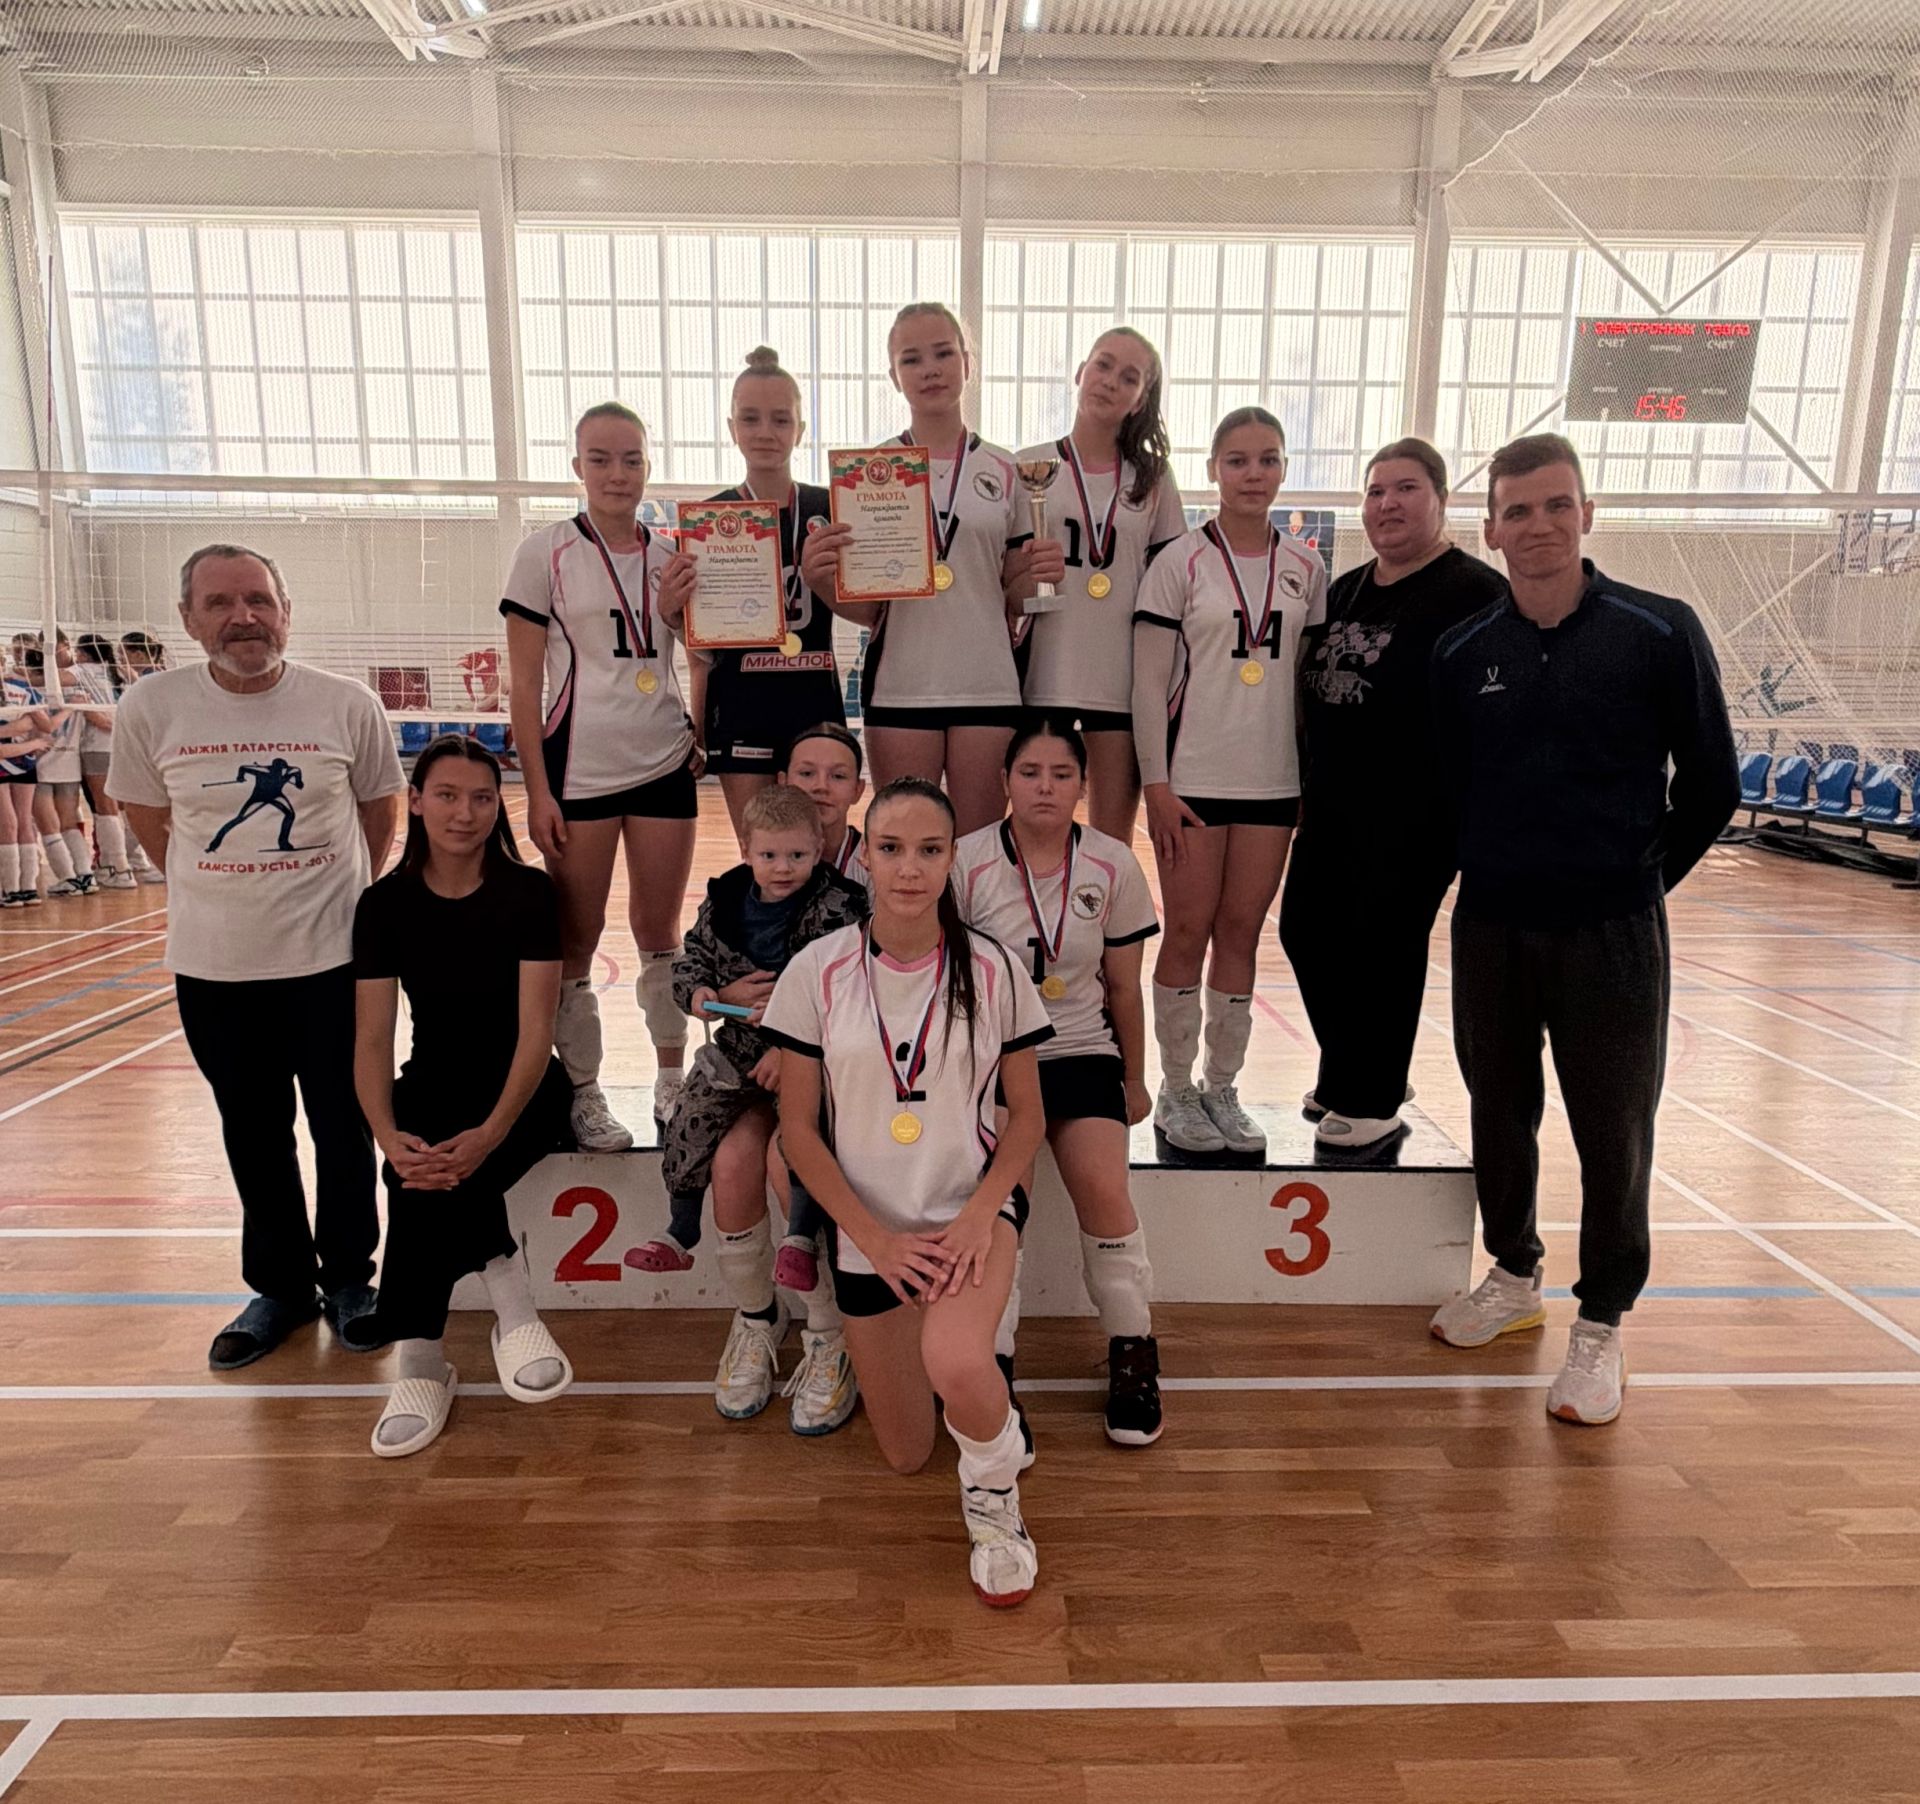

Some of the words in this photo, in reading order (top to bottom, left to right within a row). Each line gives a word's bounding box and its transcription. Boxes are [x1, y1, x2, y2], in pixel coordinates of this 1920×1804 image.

[1598, 338, 1626, 348] СЧЕТ
[856, 491, 907, 502] ГРАМОТА
[860, 504, 910, 514] Награждается
[706, 544, 758, 554] ГРАМОТА
[708, 556, 759, 565] Награждается
[179, 743, 229, 755] ЛЫЖНЯ
[232, 743, 321, 753] ТАТАРСТАНА
[259, 860, 300, 872] УСТЬЕ
[895, 1041, 927, 1102] 2
[551, 1186, 622, 1282] 2
[1264, 1181, 1332, 1277] 3
